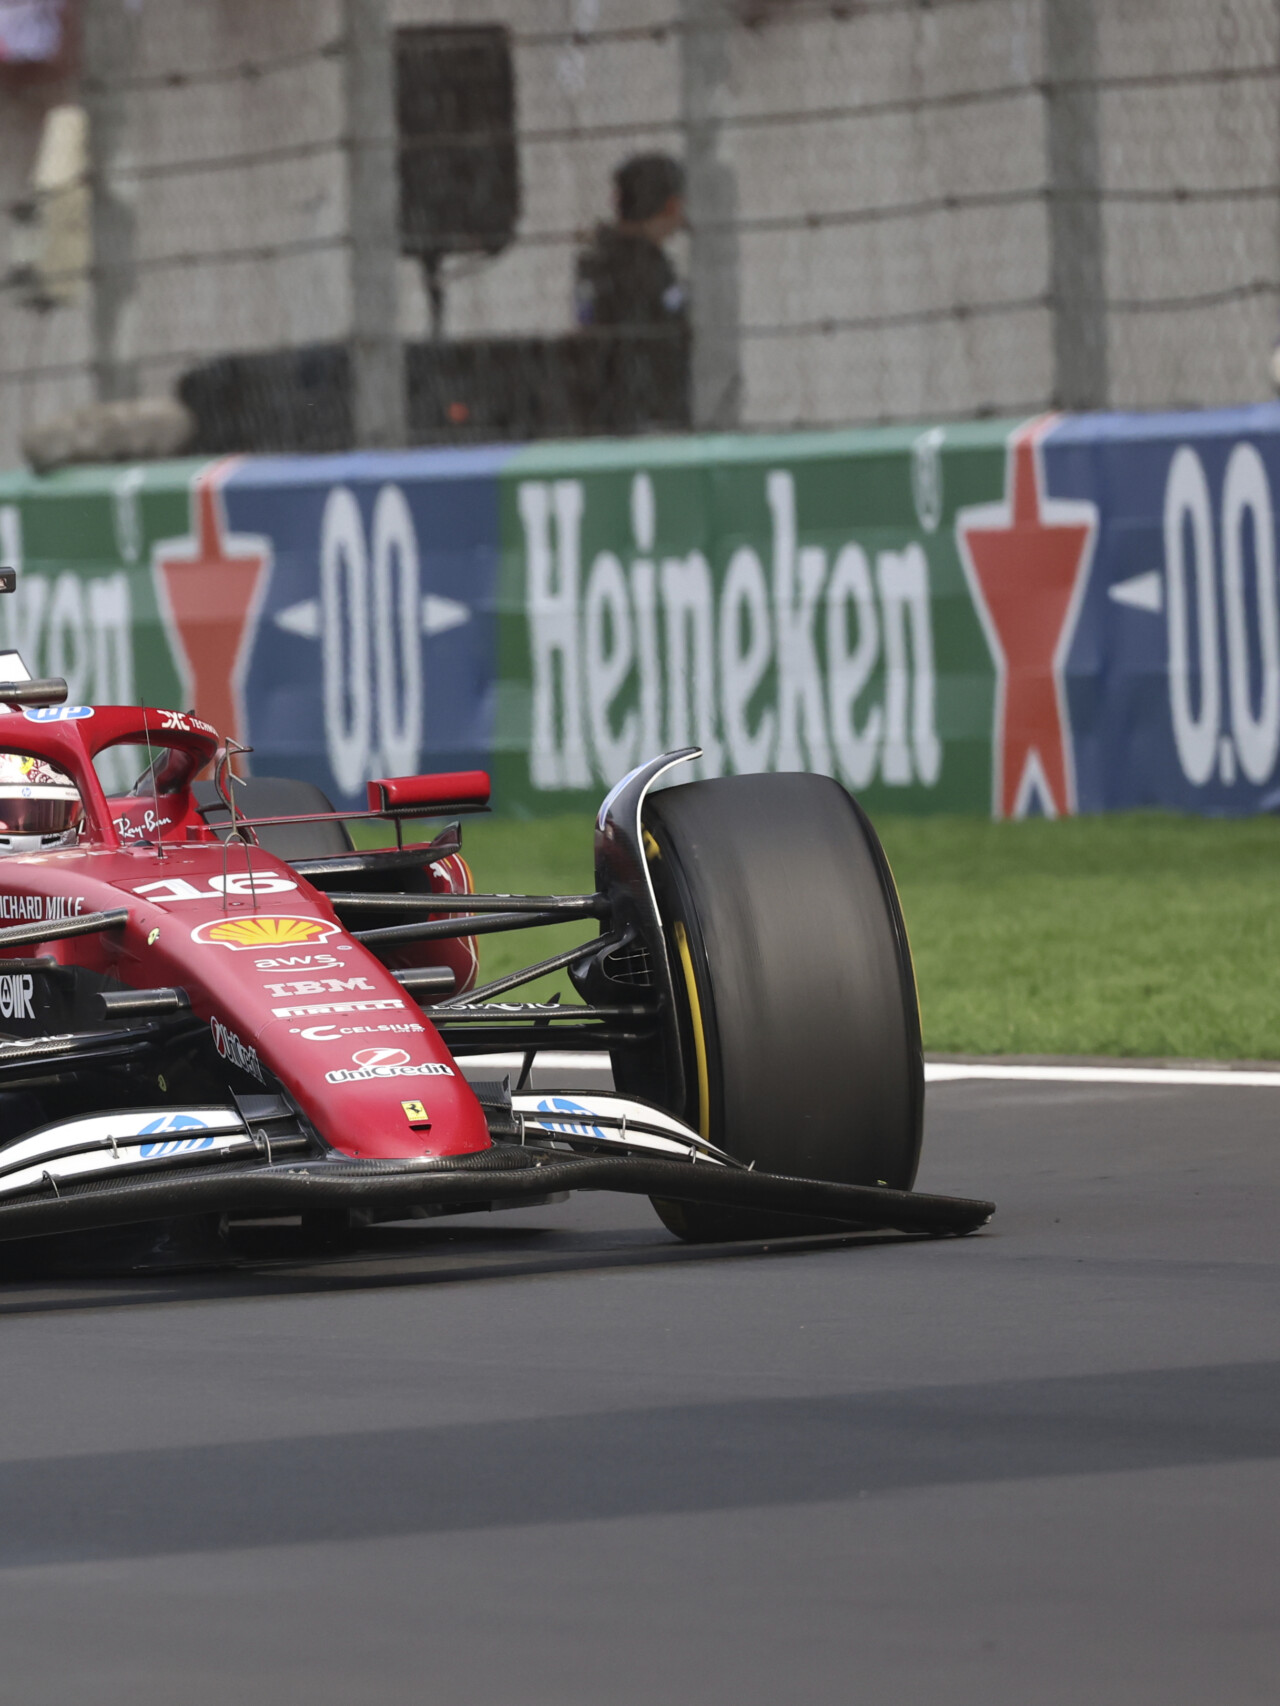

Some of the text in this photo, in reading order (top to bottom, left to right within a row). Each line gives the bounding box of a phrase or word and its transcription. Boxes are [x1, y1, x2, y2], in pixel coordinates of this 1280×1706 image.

[518, 470, 942, 790] Heineken
[113, 810, 172, 838] Ray-Ban
[132, 871, 298, 902] 16
[254, 954, 337, 969] aws
[264, 977, 376, 998] IBM
[340, 1024, 423, 1034] CELSIUS
[326, 1063, 454, 1083] UniCredit
